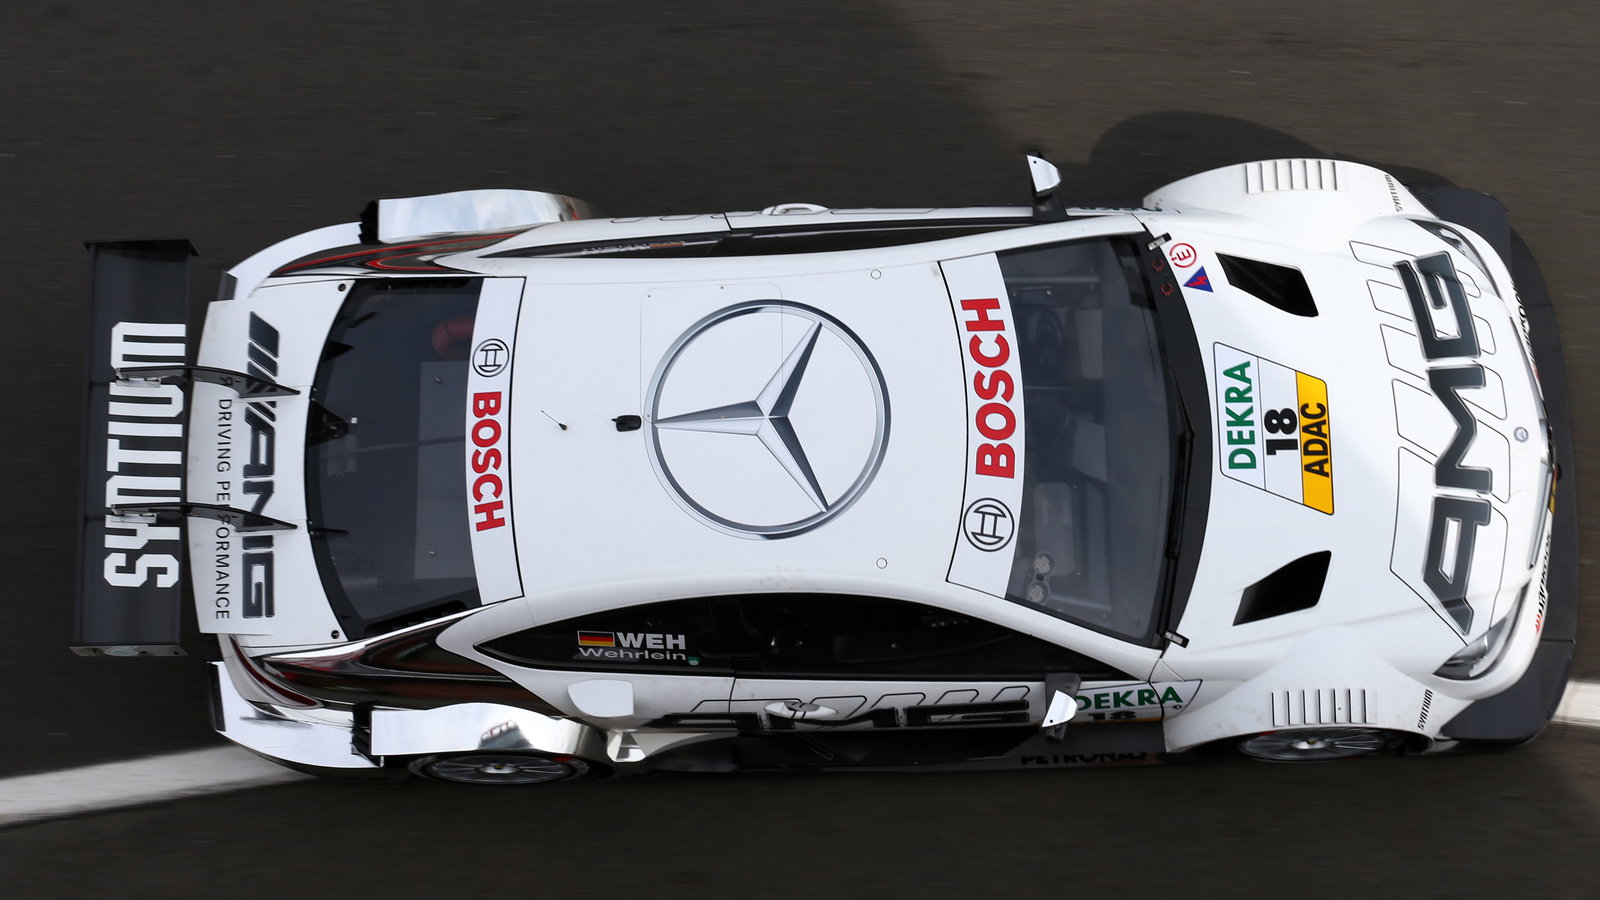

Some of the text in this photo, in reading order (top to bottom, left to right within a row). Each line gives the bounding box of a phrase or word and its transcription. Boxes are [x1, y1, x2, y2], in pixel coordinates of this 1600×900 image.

[960, 298, 1016, 479] BOSCH
[1223, 360, 1257, 469] DEKRA
[1264, 408, 1299, 455] 18
[1301, 403, 1330, 478] ADAC
[103, 321, 186, 587] SYNTIUM
[471, 391, 506, 532] BOSCH
[1393, 251, 1493, 636] AMG
[215, 399, 232, 619] DRIVING PEORMANCE
[579, 647, 687, 660] Wehrlein
[616, 632, 686, 650] WEH
[1417, 688, 1433, 730] SYNTIUM
